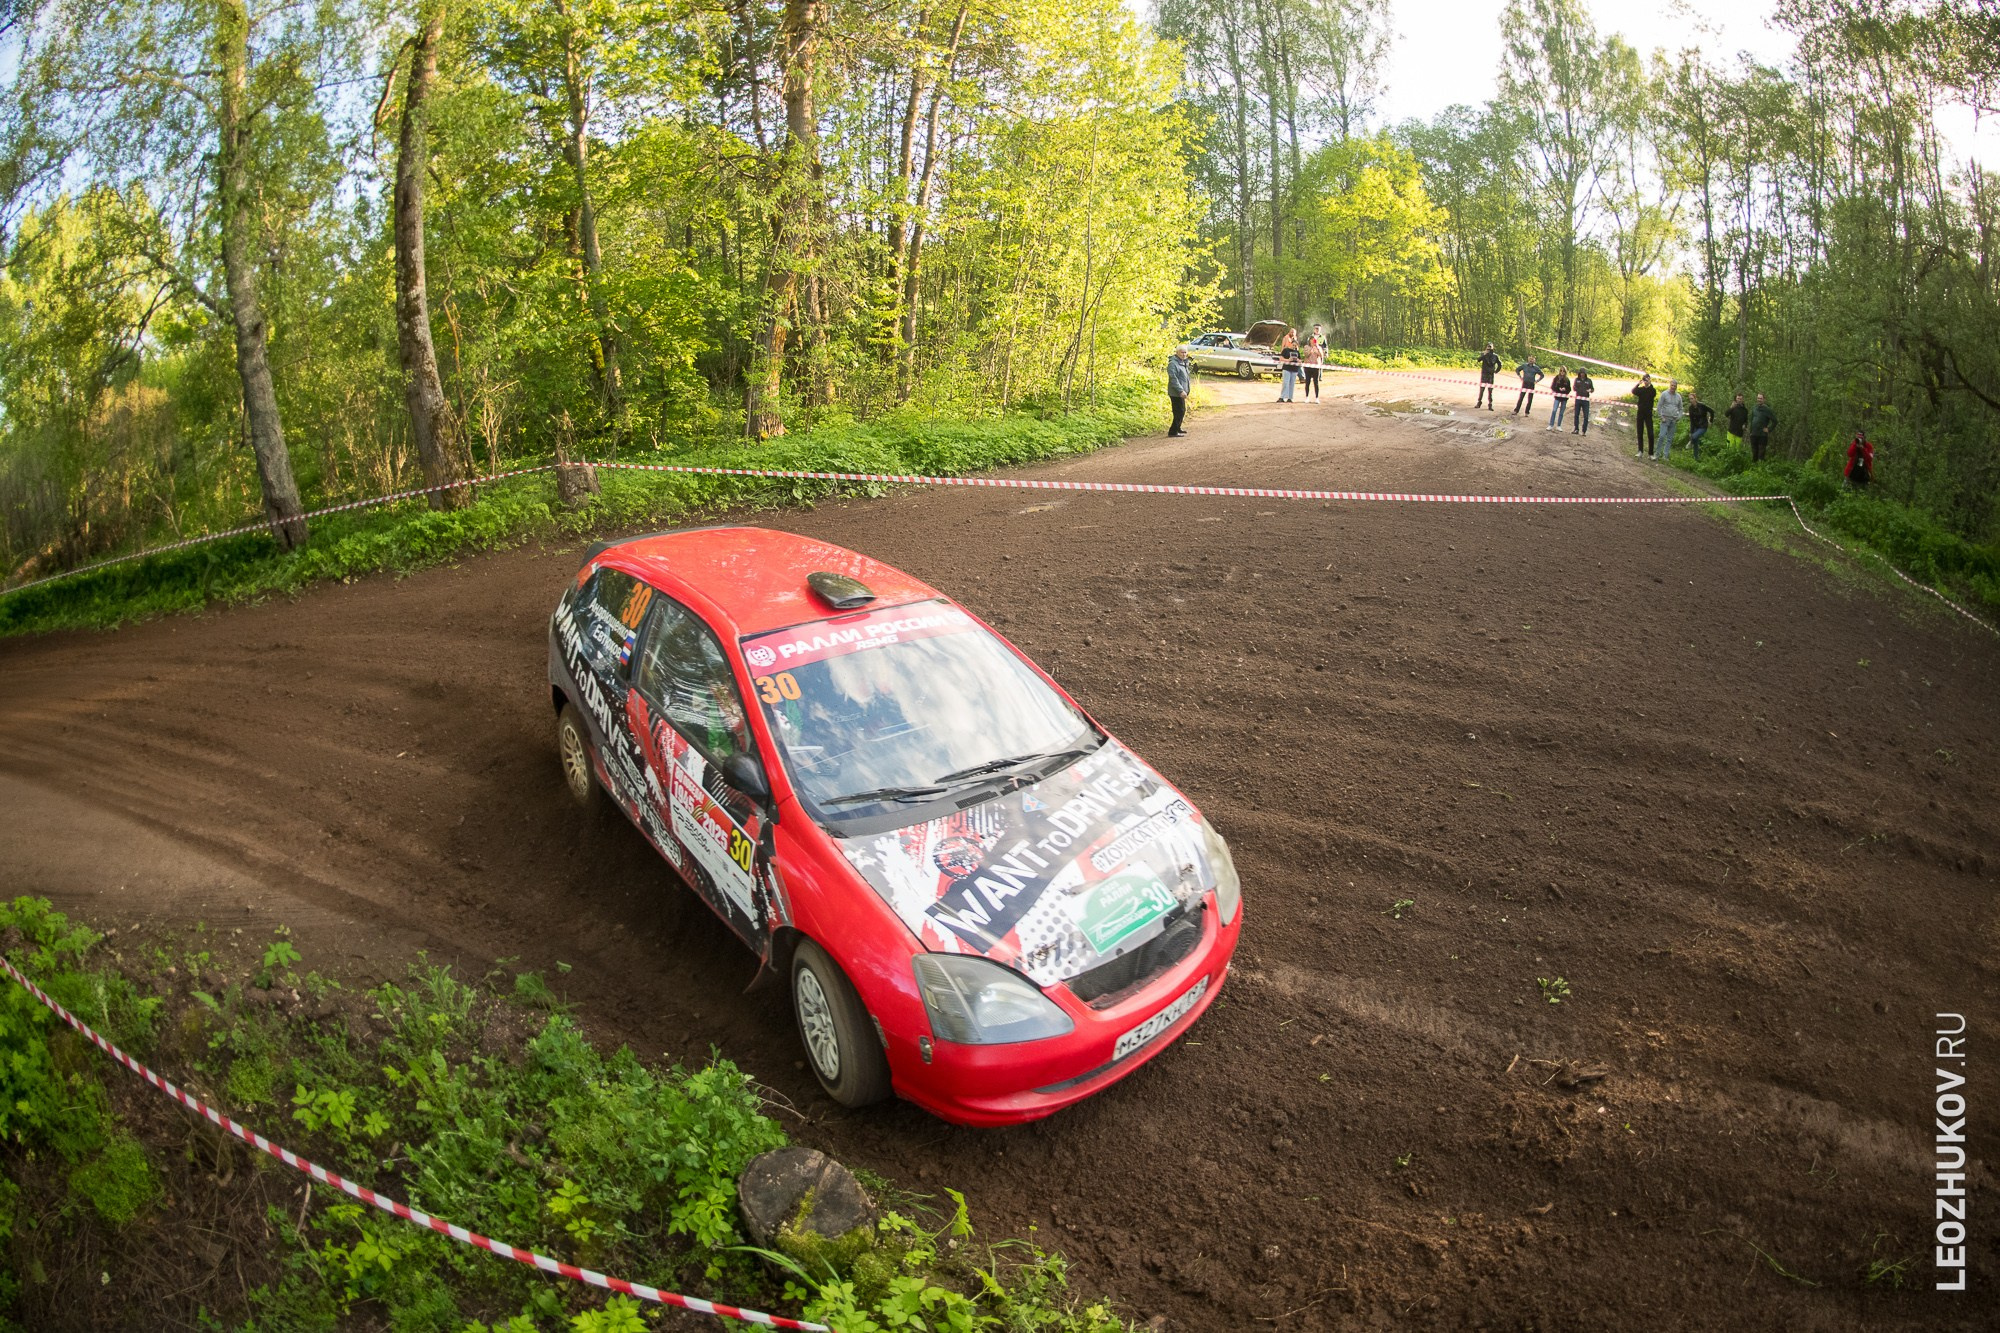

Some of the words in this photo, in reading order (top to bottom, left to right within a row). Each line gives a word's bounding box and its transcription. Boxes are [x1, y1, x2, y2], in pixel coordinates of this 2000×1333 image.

[622, 582, 652, 629] 30
[778, 627, 861, 658] РАЛЛИ
[863, 613, 946, 637] РОССИИ
[554, 588, 583, 670] WANT
[575, 660, 587, 692] TO
[585, 670, 631, 766] DRIVE
[755, 672, 802, 704] 30
[673, 781, 695, 814] 1945
[702, 812, 728, 851] 2025
[1046, 773, 1136, 839] DRIVE
[730, 829, 751, 871] 30
[1036, 827, 1073, 856] TO
[934, 839, 1050, 935] WANT
[1099, 882, 1133, 908] РАЛЛИ
[1141, 881, 1173, 912] 30
